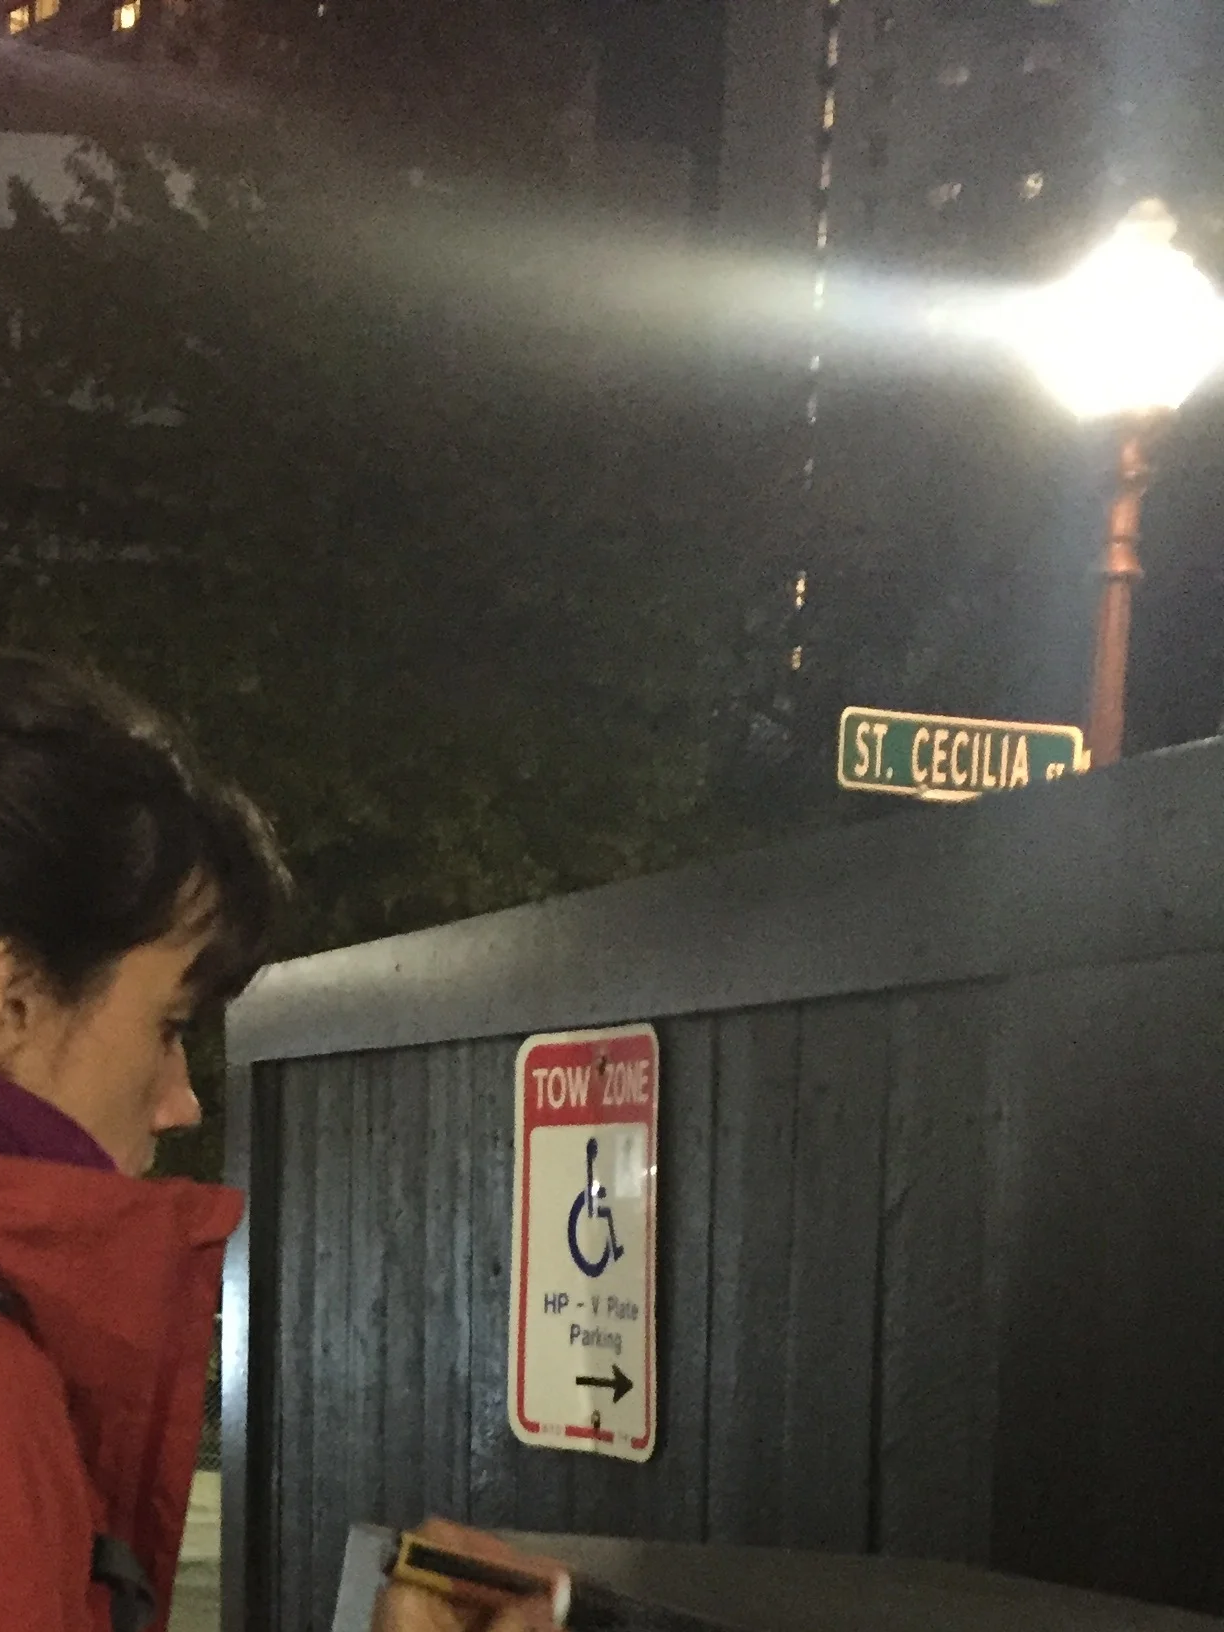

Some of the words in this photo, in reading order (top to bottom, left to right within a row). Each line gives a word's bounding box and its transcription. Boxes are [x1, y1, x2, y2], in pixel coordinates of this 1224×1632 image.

[854, 722, 893, 779] ST.
[911, 727, 1029, 790] CECILIA
[532, 1065, 591, 1109] TOW
[602, 1060, 650, 1106] ZONE
[544, 1292, 569, 1314] HP
[570, 1323, 623, 1355] Parking
